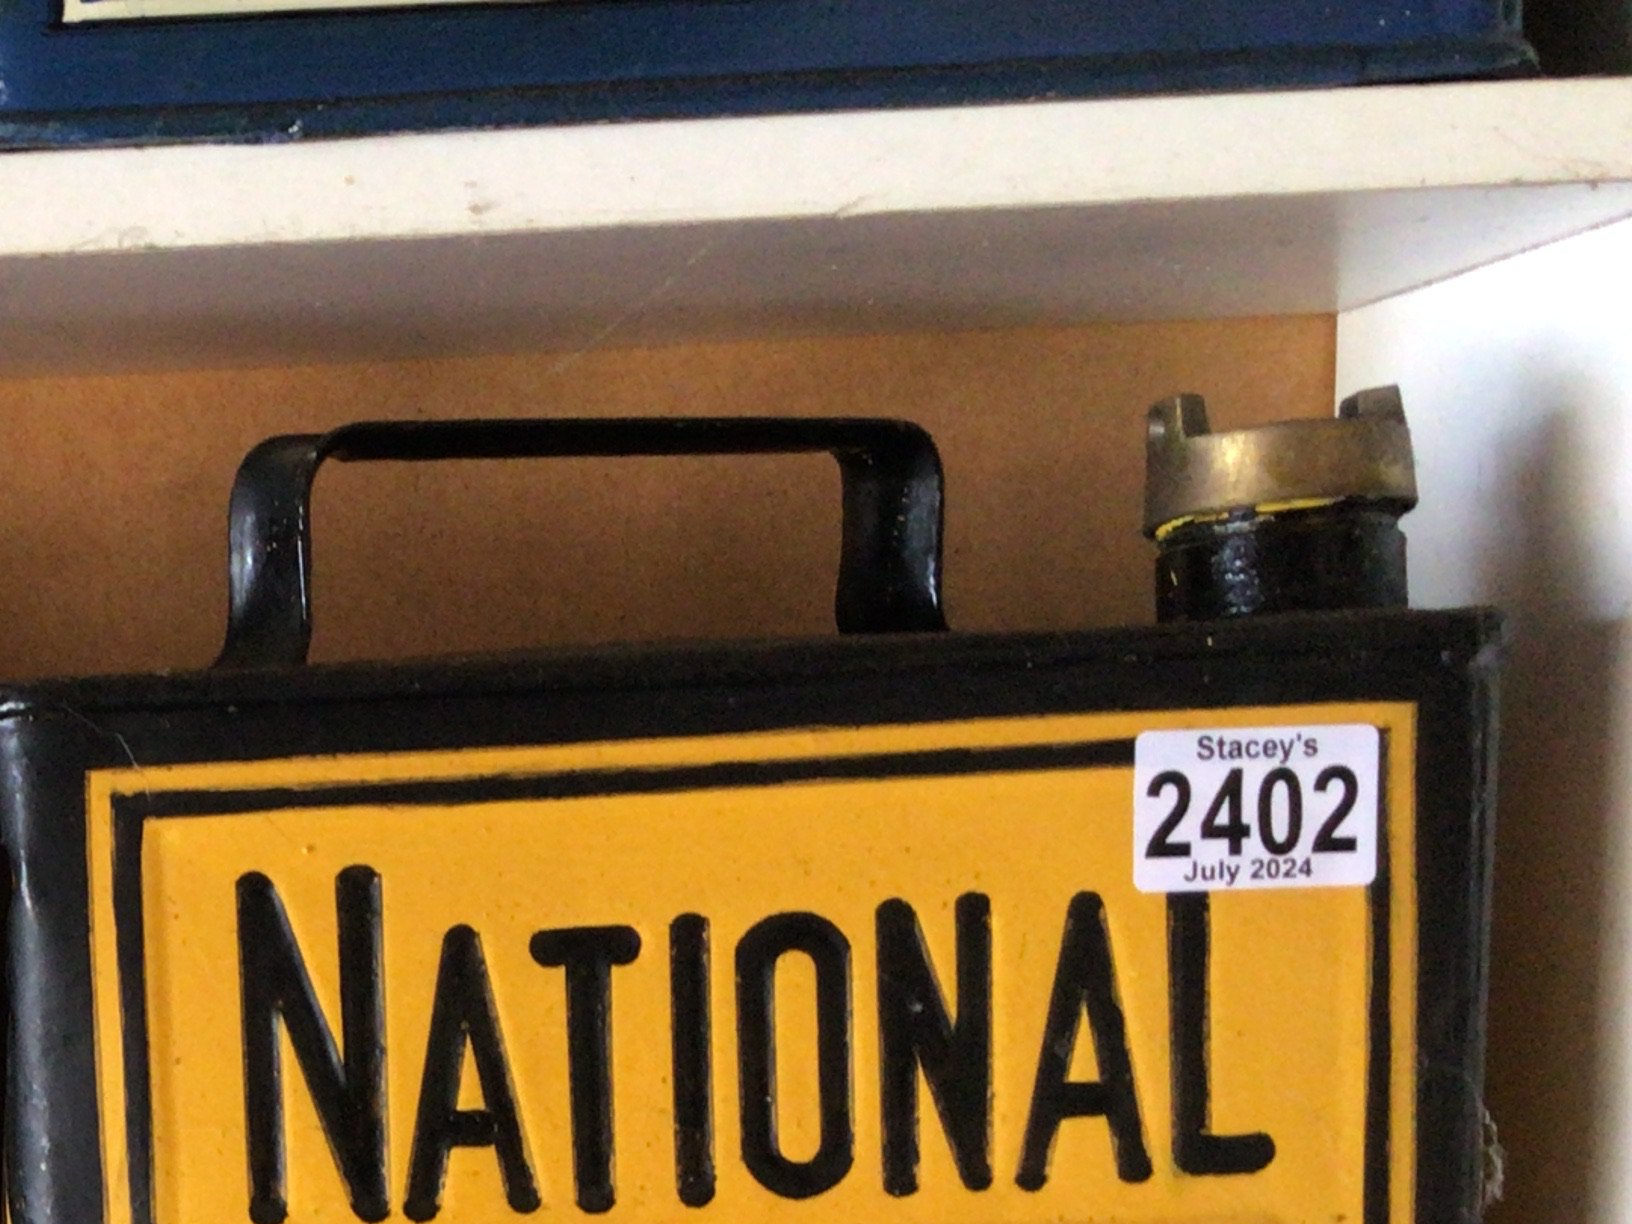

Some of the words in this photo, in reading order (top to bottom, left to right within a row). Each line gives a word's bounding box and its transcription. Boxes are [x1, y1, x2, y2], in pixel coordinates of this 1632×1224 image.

[1197, 734, 1319, 765] Stacey's
[1145, 764, 1359, 859] 2402
[1183, 861, 1241, 886] July
[1250, 857, 1313, 880] 2024
